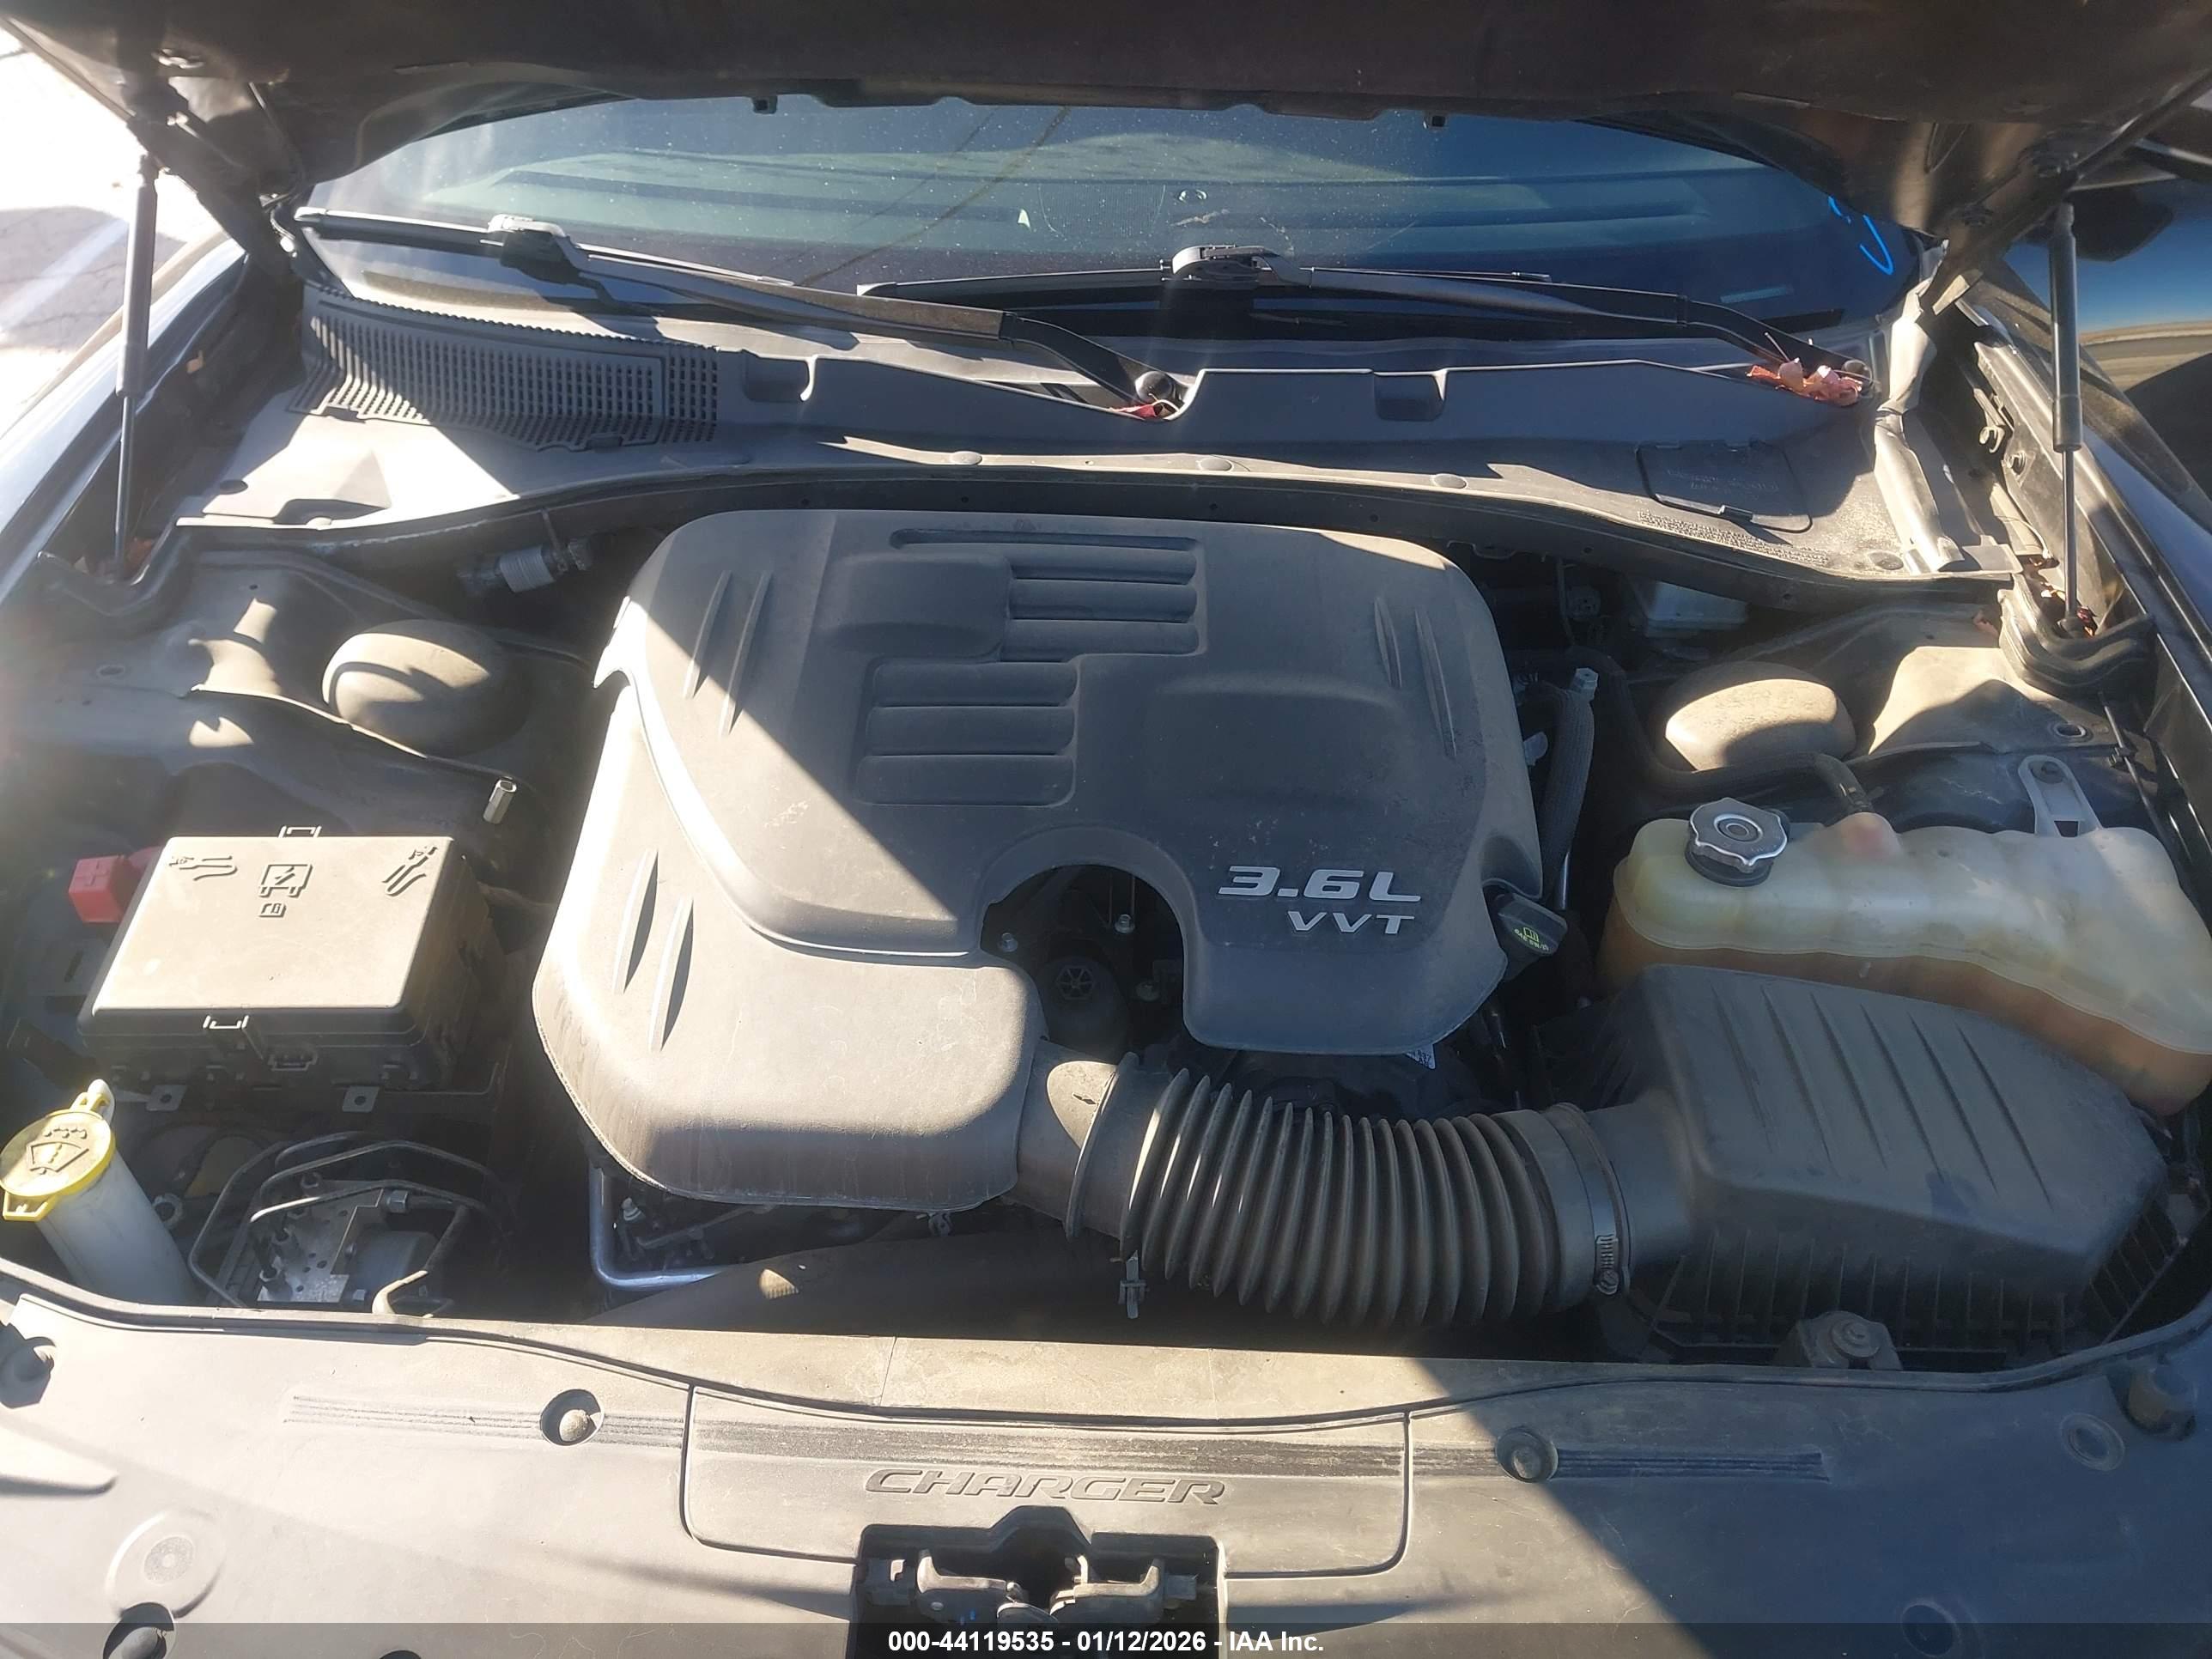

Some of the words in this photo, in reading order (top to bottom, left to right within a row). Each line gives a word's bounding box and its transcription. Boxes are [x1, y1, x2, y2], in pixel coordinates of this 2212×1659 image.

[1218, 865, 1422, 902] 3.6L
[1287, 910, 1415, 934] VVT
[865, 1468, 1225, 1505] CHARGER
